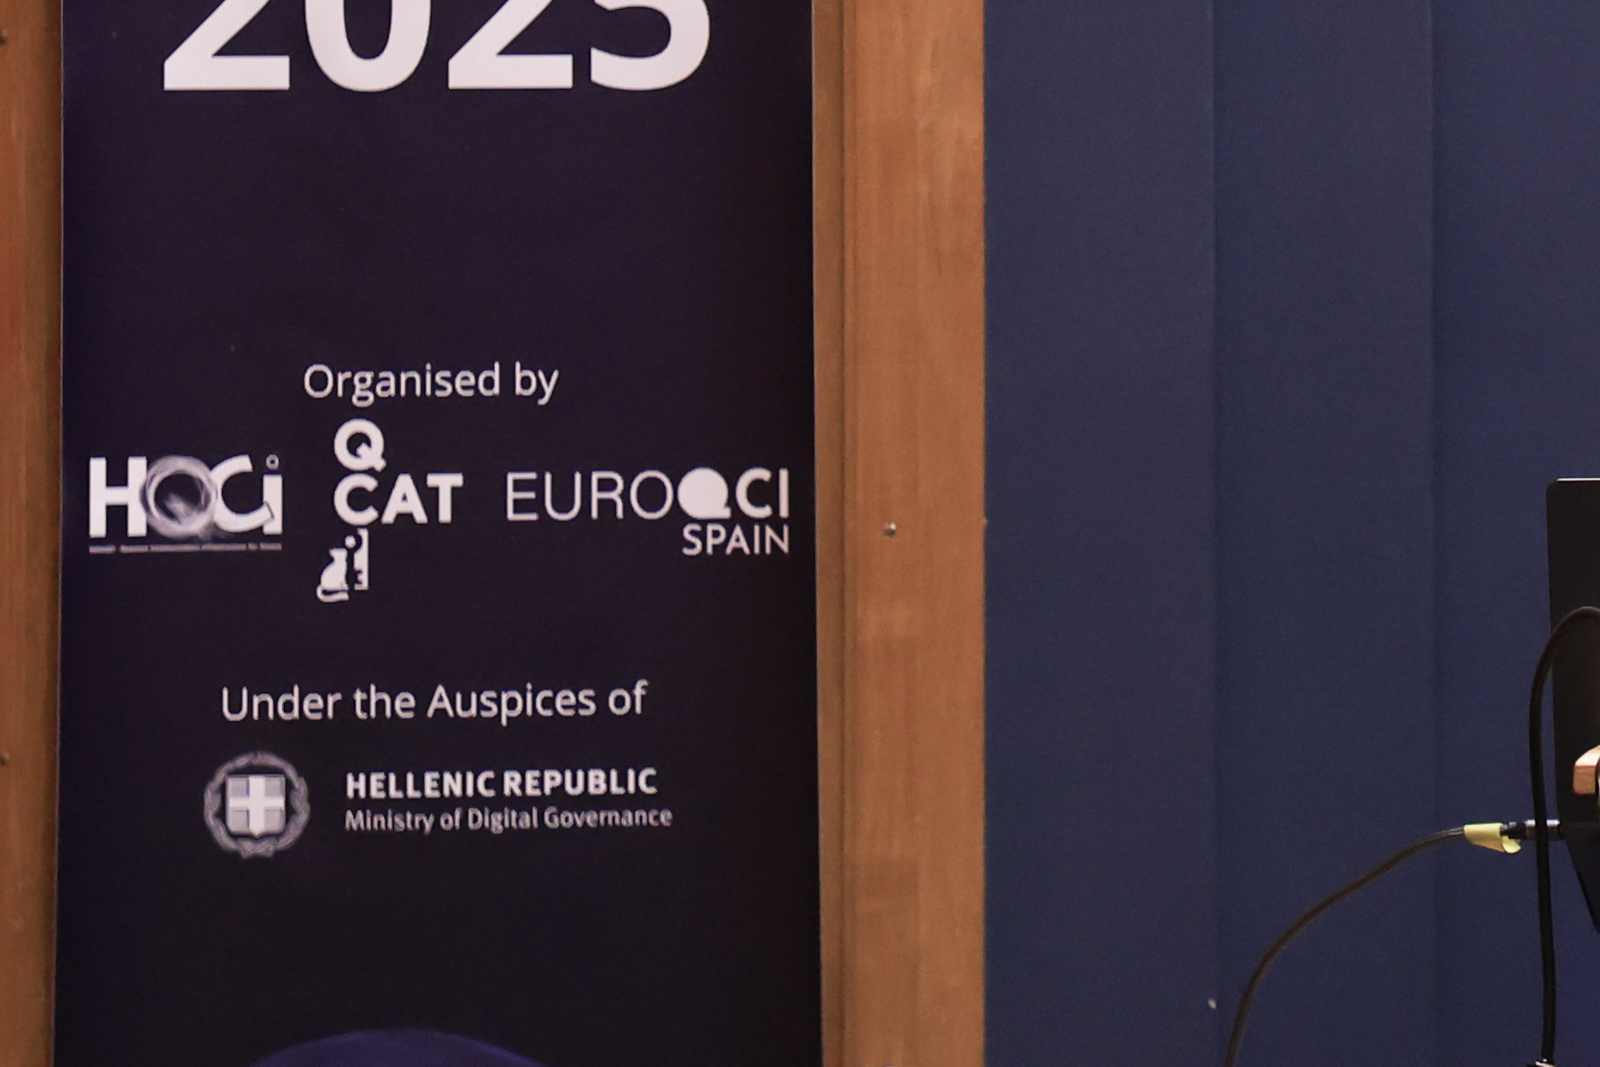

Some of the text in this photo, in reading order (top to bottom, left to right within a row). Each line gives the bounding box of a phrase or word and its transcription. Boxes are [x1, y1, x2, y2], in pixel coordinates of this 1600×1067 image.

[304, 360, 559, 408] Organised by
[333, 418, 387, 472] Q
[333, 472, 464, 526] CAT
[682, 524, 789, 556] SPAIN
[222, 679, 648, 727] Under the Auspices of
[346, 767, 658, 799] HELLENIC REPUBLIC
[345, 806, 673, 834] Ministry of Digital Governance
